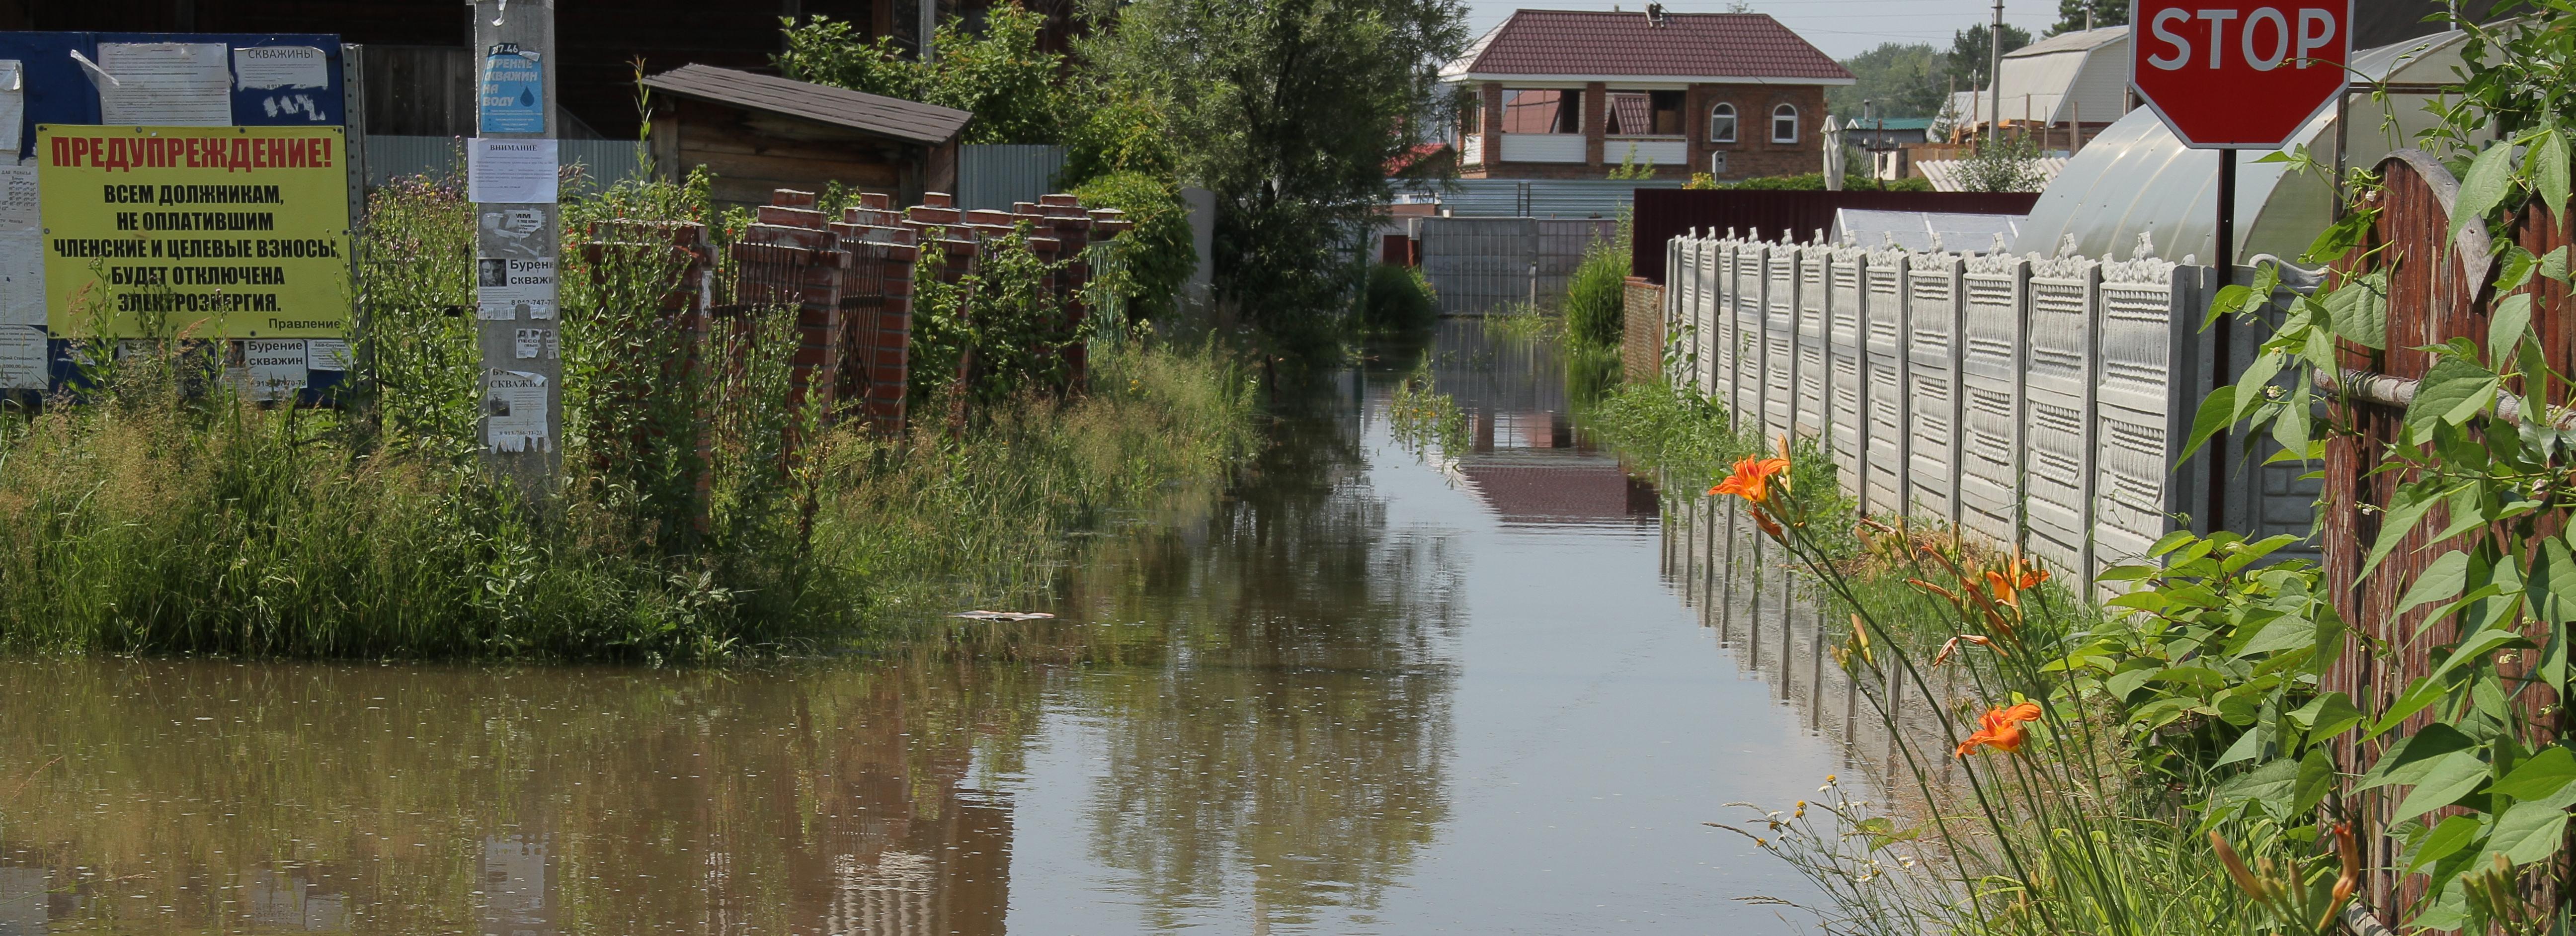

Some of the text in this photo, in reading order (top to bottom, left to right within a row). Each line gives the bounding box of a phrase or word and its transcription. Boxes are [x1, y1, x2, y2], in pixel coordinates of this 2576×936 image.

[2147, 7, 2335, 71] STOP
[248, 50, 313, 59] СКВАЖИНЫ
[483, 84, 499, 94] НА
[483, 96, 515, 106] ВОДУ
[51, 137, 331, 172] ПРЕДУПРЕЖДЕНИЕ!
[104, 185, 284, 206] ВСЕМ ДОЛЖНИКАМ,
[117, 212, 273, 231] НЕ ОПЛАТИВШИМ
[54, 239, 147, 257] ЧЛЕНСКИЕ
[151, 239, 162, 257] И
[167, 239, 252, 260] ЦЕЛЕВЫЕ
[111, 266, 285, 287] БУДЕТ ОТКЛЮЧЕНА
[269, 318, 340, 331] Правление
[249, 341, 303, 353] Бурение
[249, 357, 303, 366] скважин
